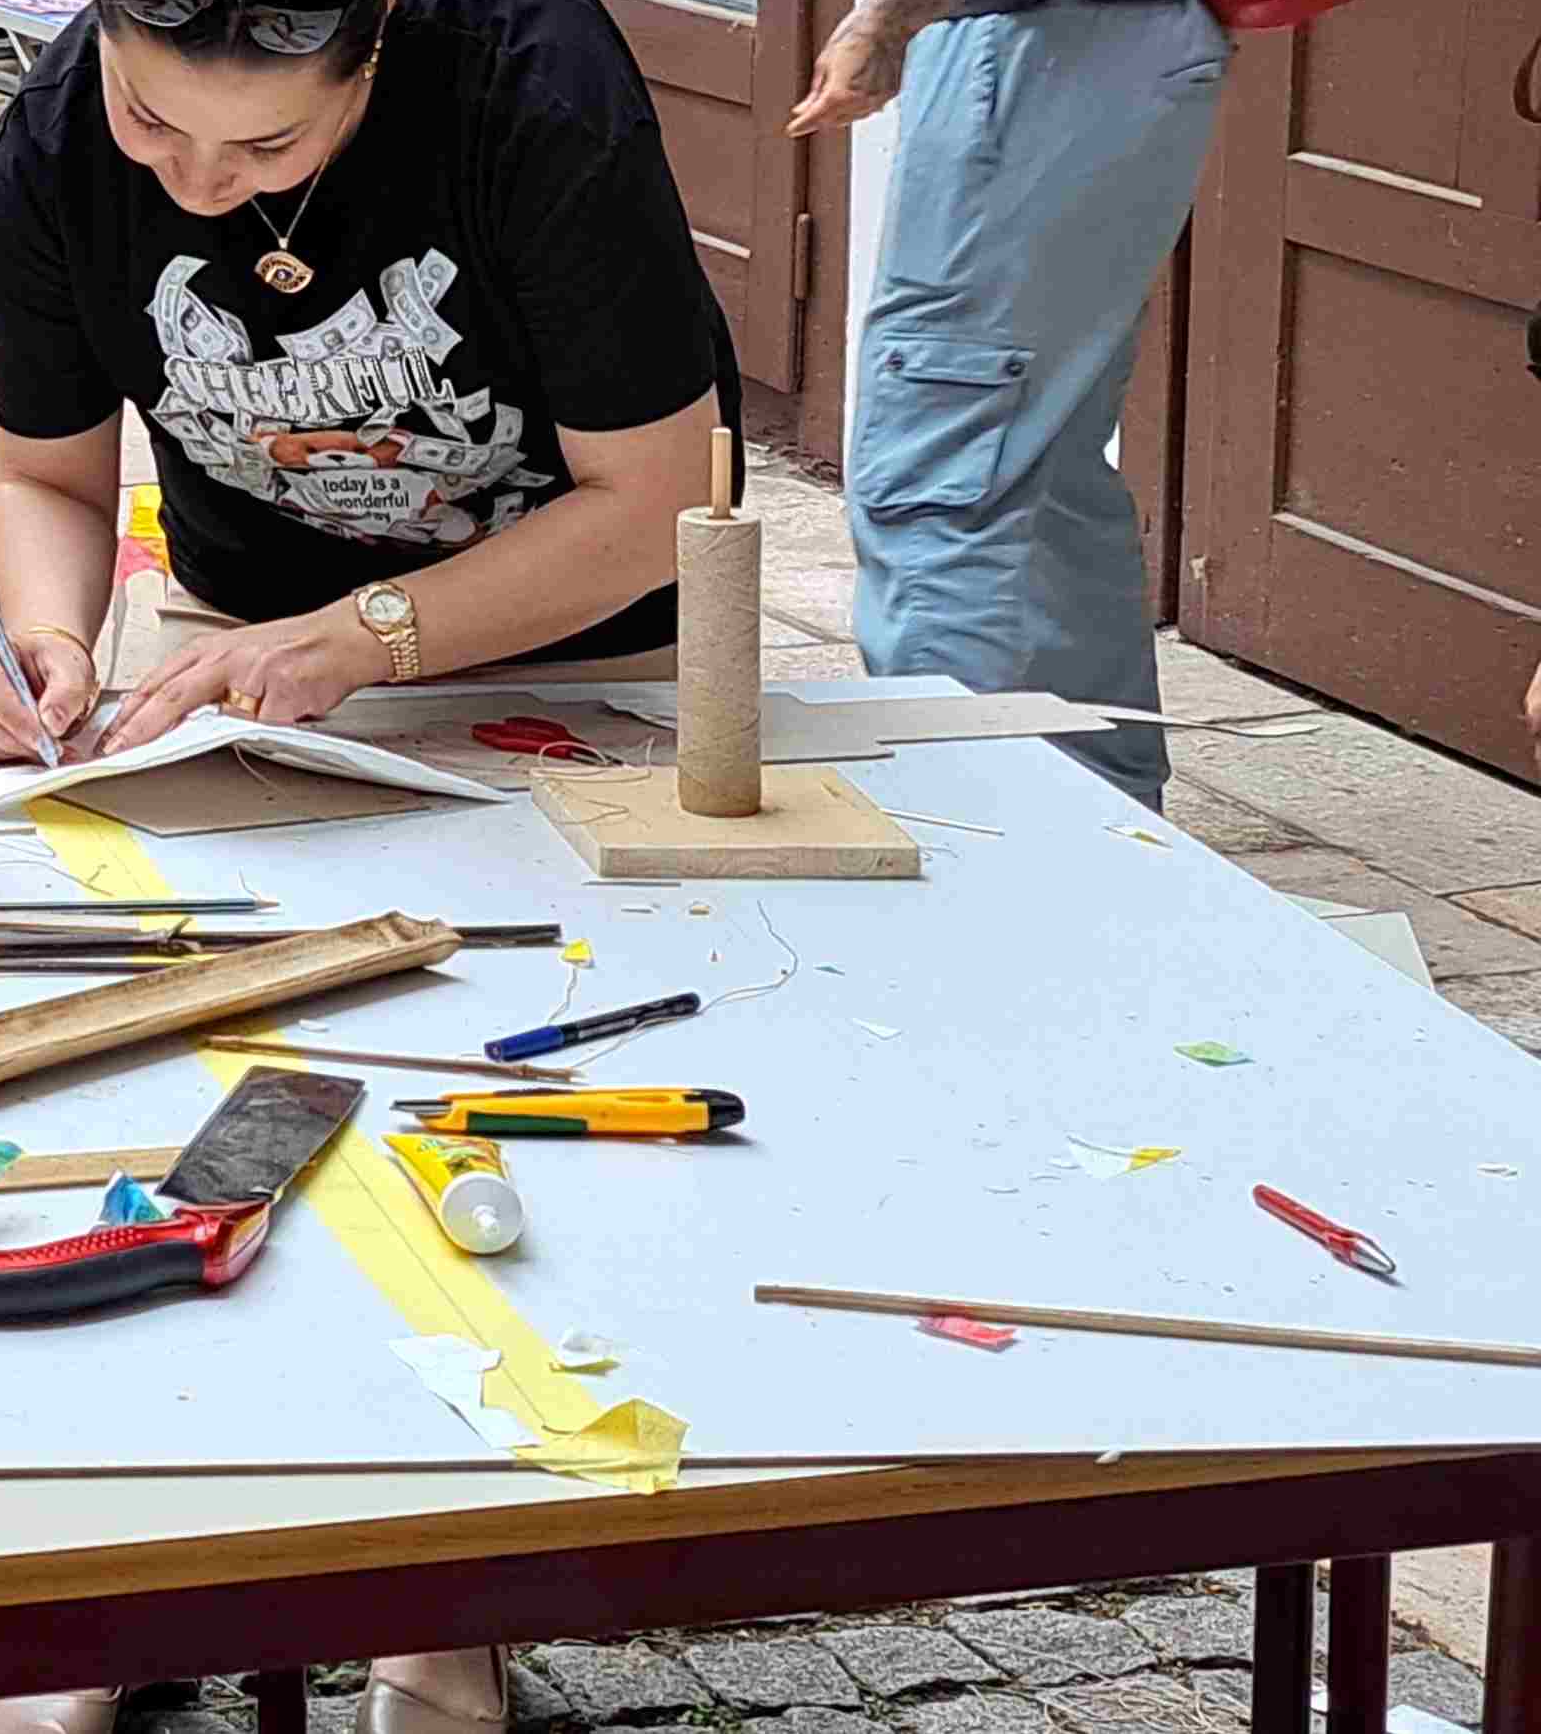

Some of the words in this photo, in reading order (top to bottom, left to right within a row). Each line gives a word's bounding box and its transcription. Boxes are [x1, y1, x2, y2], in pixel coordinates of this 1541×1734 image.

[322, 475, 367, 496] today
[372, 474, 387, 491] is
[390, 477, 401, 491] a
